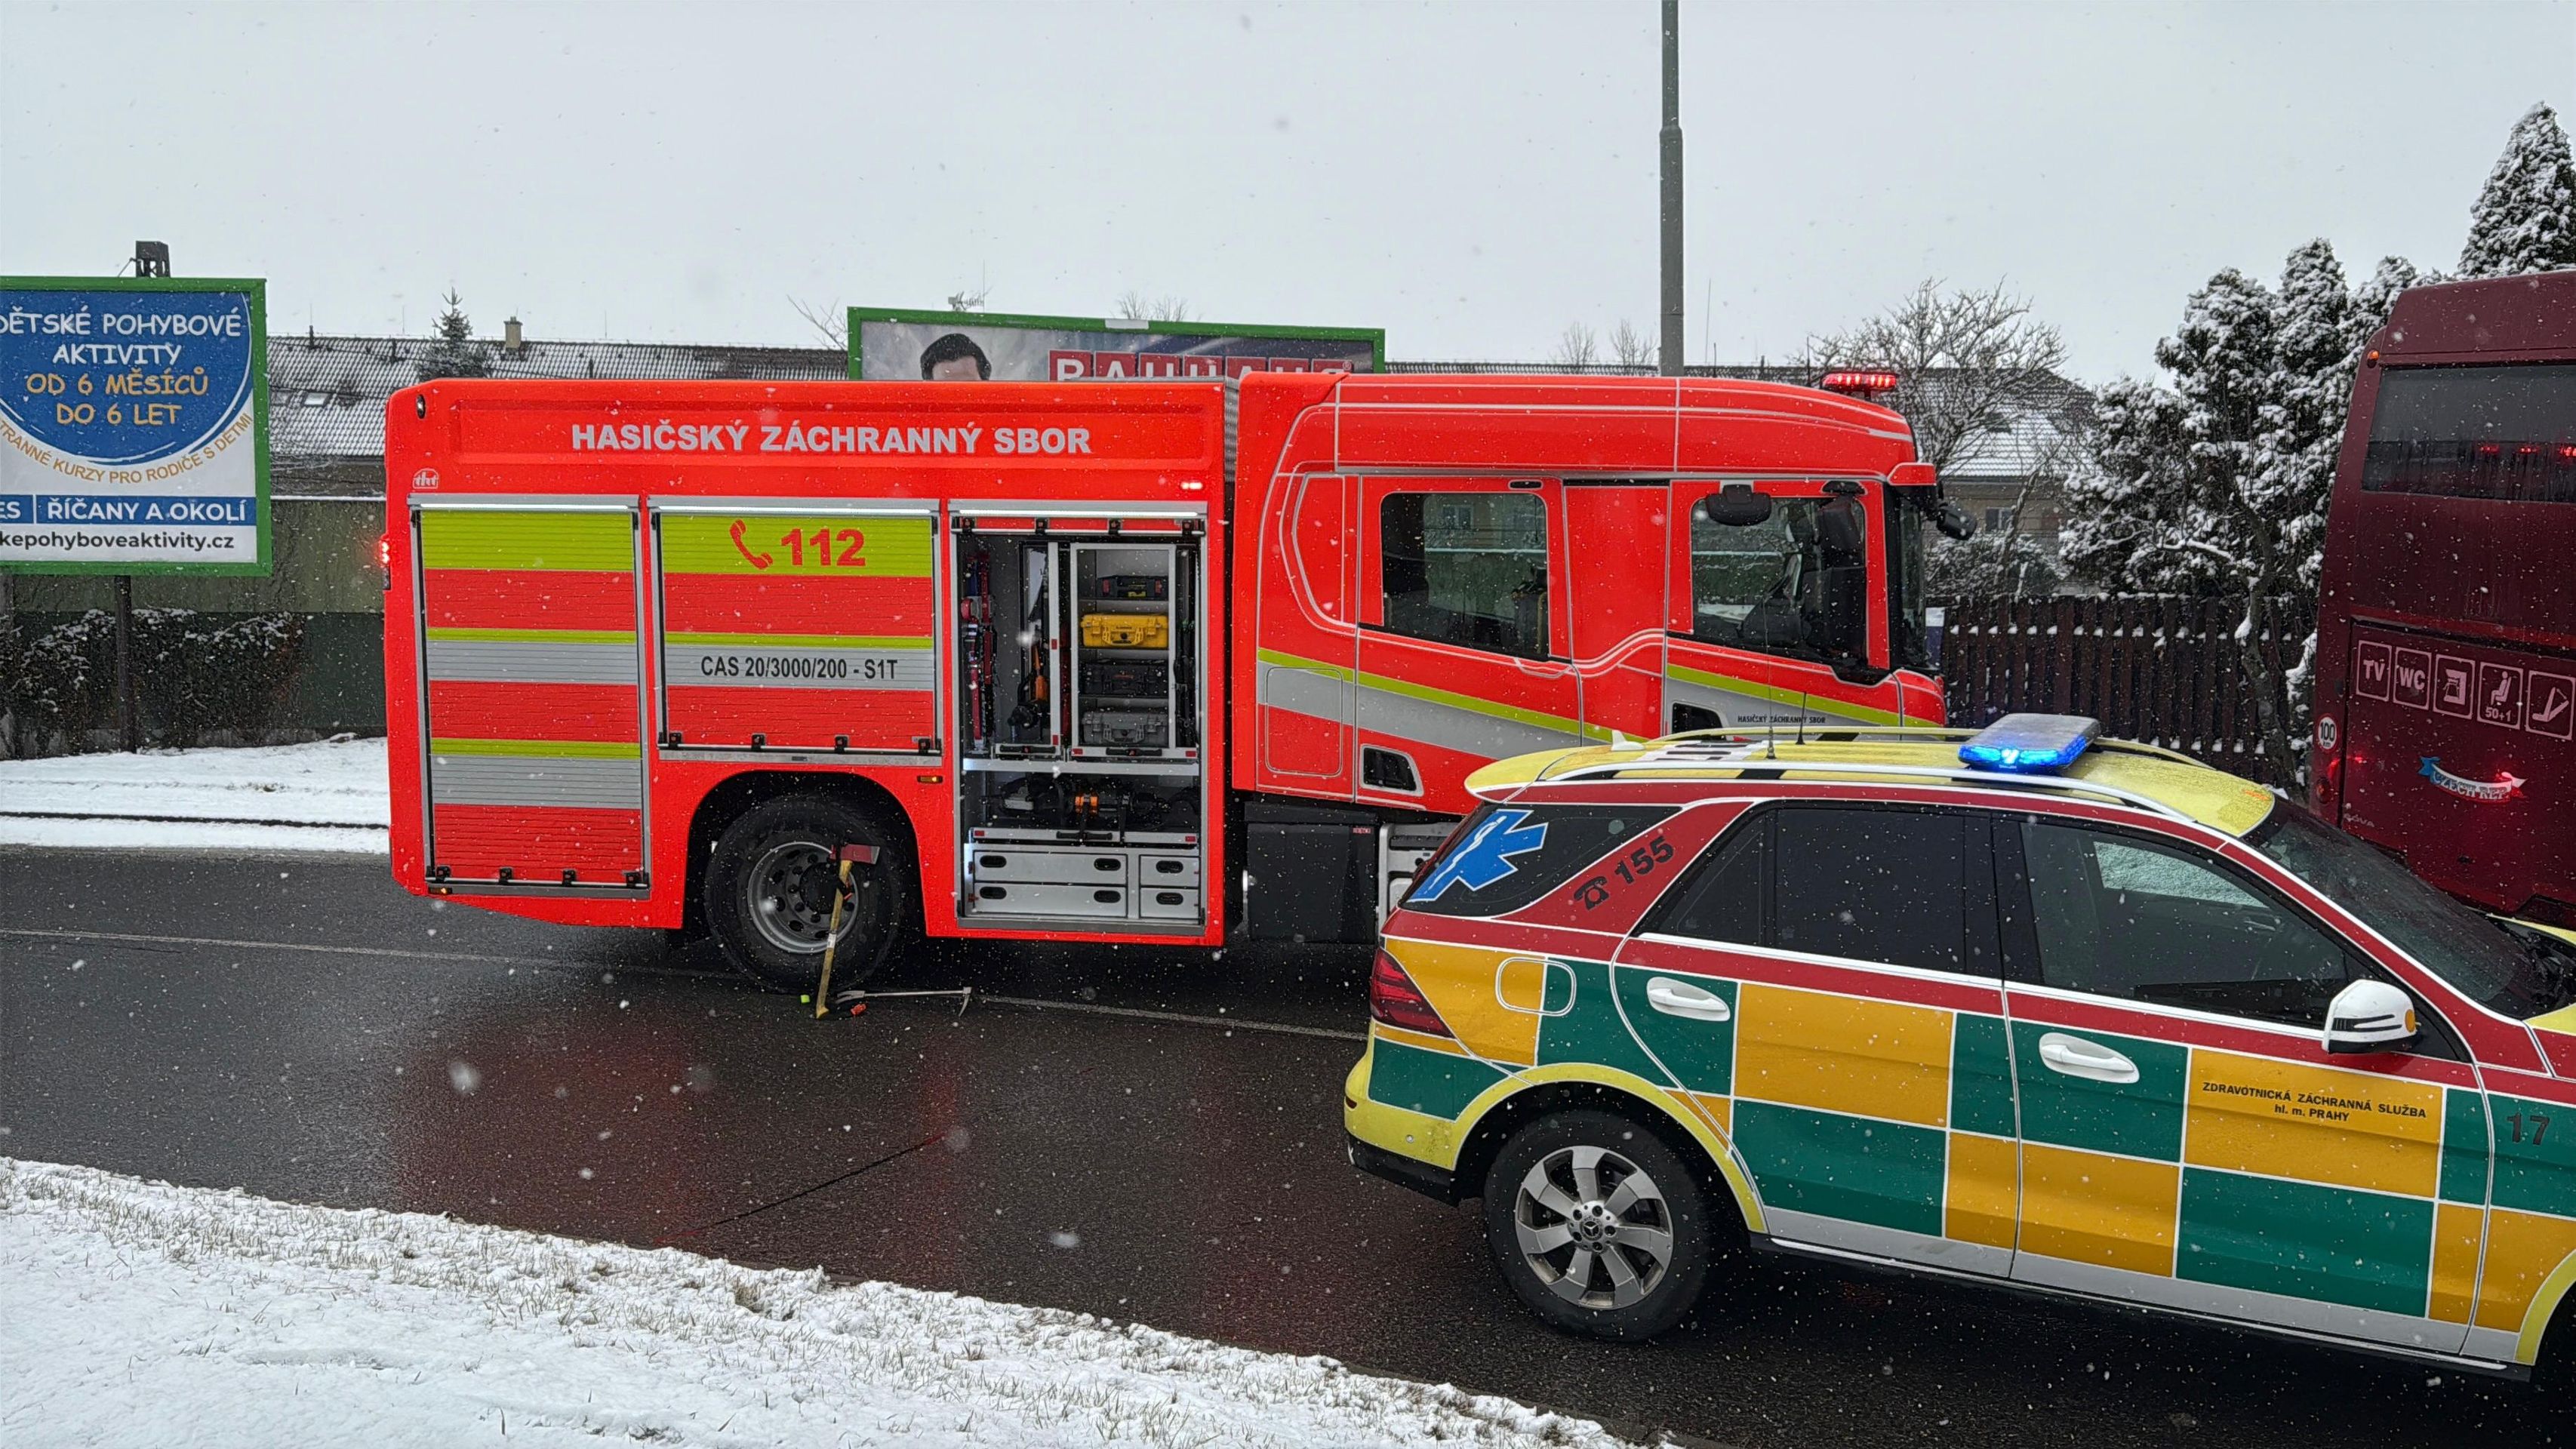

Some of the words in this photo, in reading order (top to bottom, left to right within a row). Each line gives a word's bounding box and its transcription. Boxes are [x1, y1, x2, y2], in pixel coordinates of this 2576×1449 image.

[103, 306, 242, 337] POHYBOVÉ
[52, 343, 182, 365] AKTIVITY
[26, 374, 66, 395] OD
[77, 374, 93, 395] 6
[105, 366, 208, 395] MĚSÍCŮ
[57, 402, 95, 424] DO
[106, 403, 122, 424] 6
[134, 404, 182, 425] LET
[572, 419, 749, 451] HASIČSKÝ
[759, 419, 982, 453] ZÁCHRANNÝ
[993, 427, 1092, 454] SBOR
[53, 458, 106, 482] KURZY
[109, 470, 142, 484] PRO
[146, 455, 204, 481] RODIČE
[203, 447, 215, 459] S
[48, 497, 140, 521] ŘÍČANY
[146, 503, 165, 521] A
[170, 499, 246, 521] OKOLÍ
[780, 528, 866, 567] 112
[701, 656, 740, 677] CAS
[745, 657, 847, 678] 20/3000/200
[864, 659, 898, 679] S1T
[2363, 659, 2385, 681] TV
[2399, 666, 2425, 690] WC
[2485, 707, 2512, 722] 50+1
[2320, 721, 2336, 742] 100
[1614, 835, 1675, 884] 155
[2202, 1082, 2291, 1101] ZDRAVOTNICKÁ
[2297, 1093, 2372, 1111] ZÁCHRANNÁ
[2377, 1103, 2427, 1118] SLUŽBA
[2275, 1104, 2288, 1114] hl.
[2292, 1108, 2306, 1117] m.
[2310, 1109, 2350, 1121] PRAHY
[2507, 1112, 2550, 1146] 17
